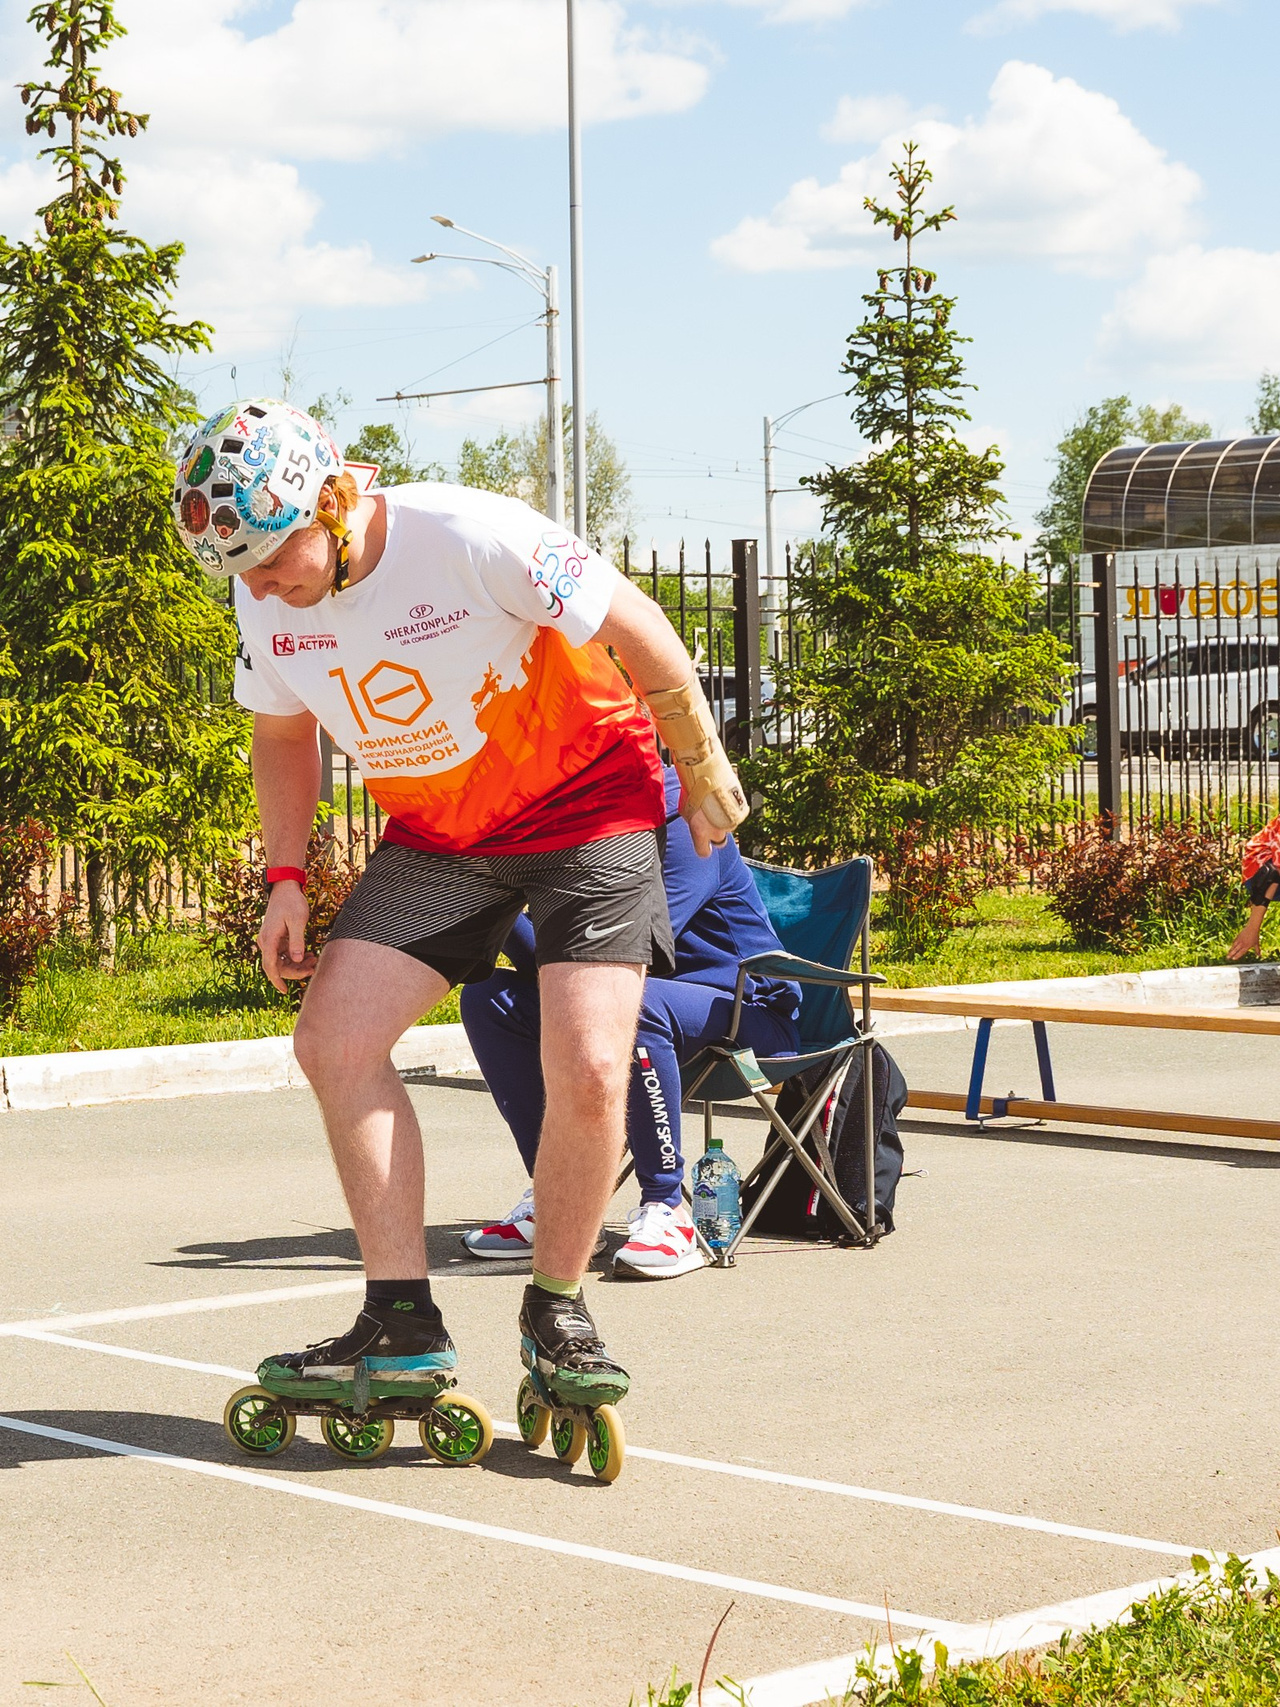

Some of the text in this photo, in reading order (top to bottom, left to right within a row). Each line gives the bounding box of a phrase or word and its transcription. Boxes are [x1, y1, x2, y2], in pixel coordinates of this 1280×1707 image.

[281, 449, 311, 491] 55
[384, 608, 470, 641] SHERATONPLAZA
[415, 606, 427, 618] SP
[298, 640, 339, 651] АСТРУМ
[411, 631, 440, 644] CONGRESS
[440, 624, 460, 635] HOTEL
[355, 719, 449, 751] УФИМСКИЙ
[362, 732, 454, 759] МЕЖДУНАРОДНЫЙ
[367, 742, 460, 770] МАРАФОН
[641, 1067, 677, 1170] TOMMY SPORT
